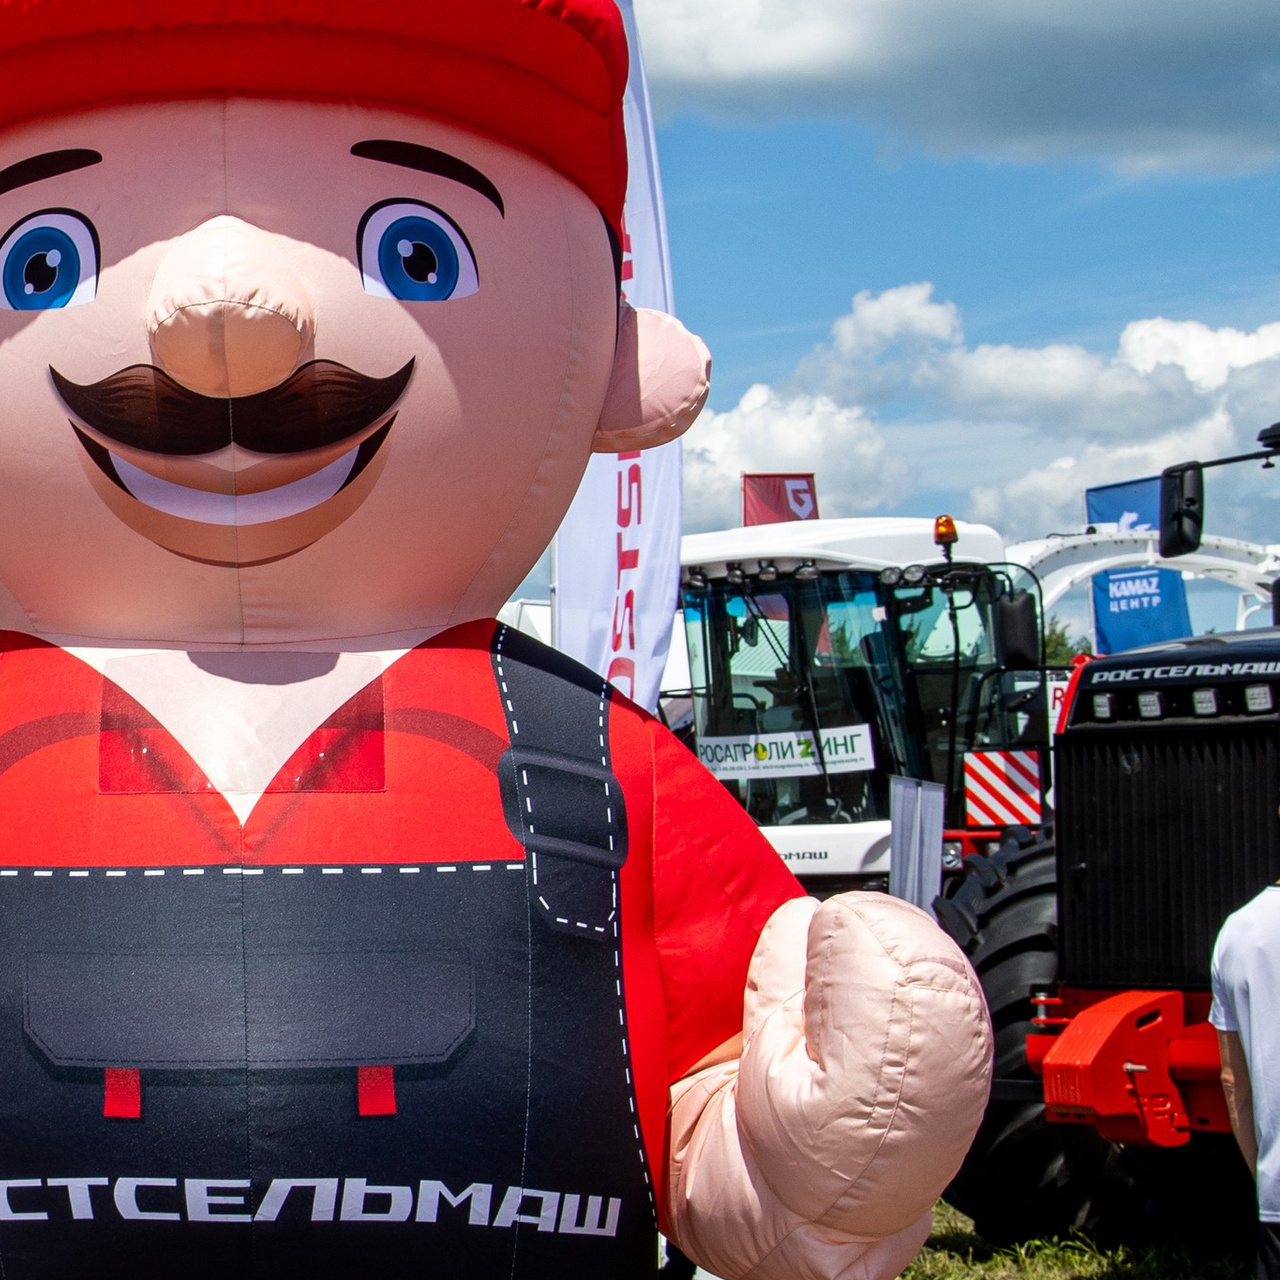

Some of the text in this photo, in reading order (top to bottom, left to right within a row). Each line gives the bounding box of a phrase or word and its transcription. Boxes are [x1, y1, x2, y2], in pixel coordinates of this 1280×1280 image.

[1108, 577, 1160, 599] KAMAZ
[1109, 595, 1162, 613] ЦЕНТР
[1091, 662, 1280, 684] РОСТСЕЛЬМАШ
